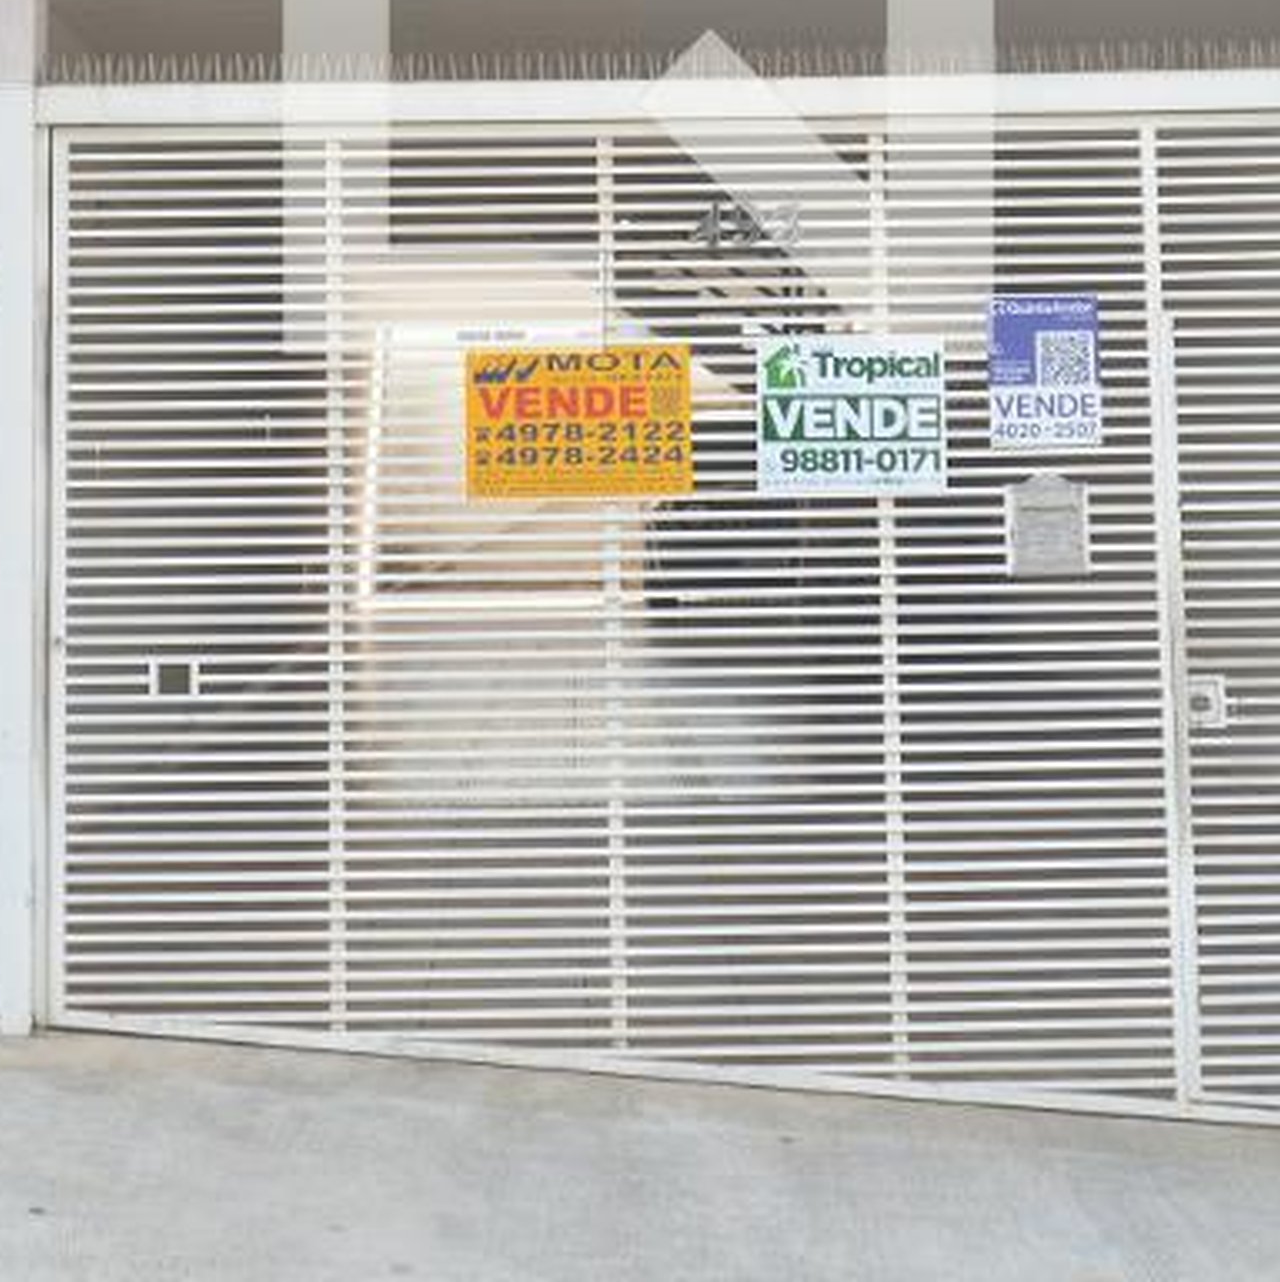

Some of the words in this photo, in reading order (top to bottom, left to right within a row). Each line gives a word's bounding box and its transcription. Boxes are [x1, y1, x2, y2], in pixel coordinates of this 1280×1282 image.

[811, 350, 940, 385] Tropical
[478, 386, 648, 419] VENDE
[994, 393, 1098, 419] VENDE
[495, 421, 685, 442] 4978-2122
[766, 398, 939, 439] VENDE
[495, 446, 684, 466] 4978-2424
[780, 448, 942, 473] 98811-0171
